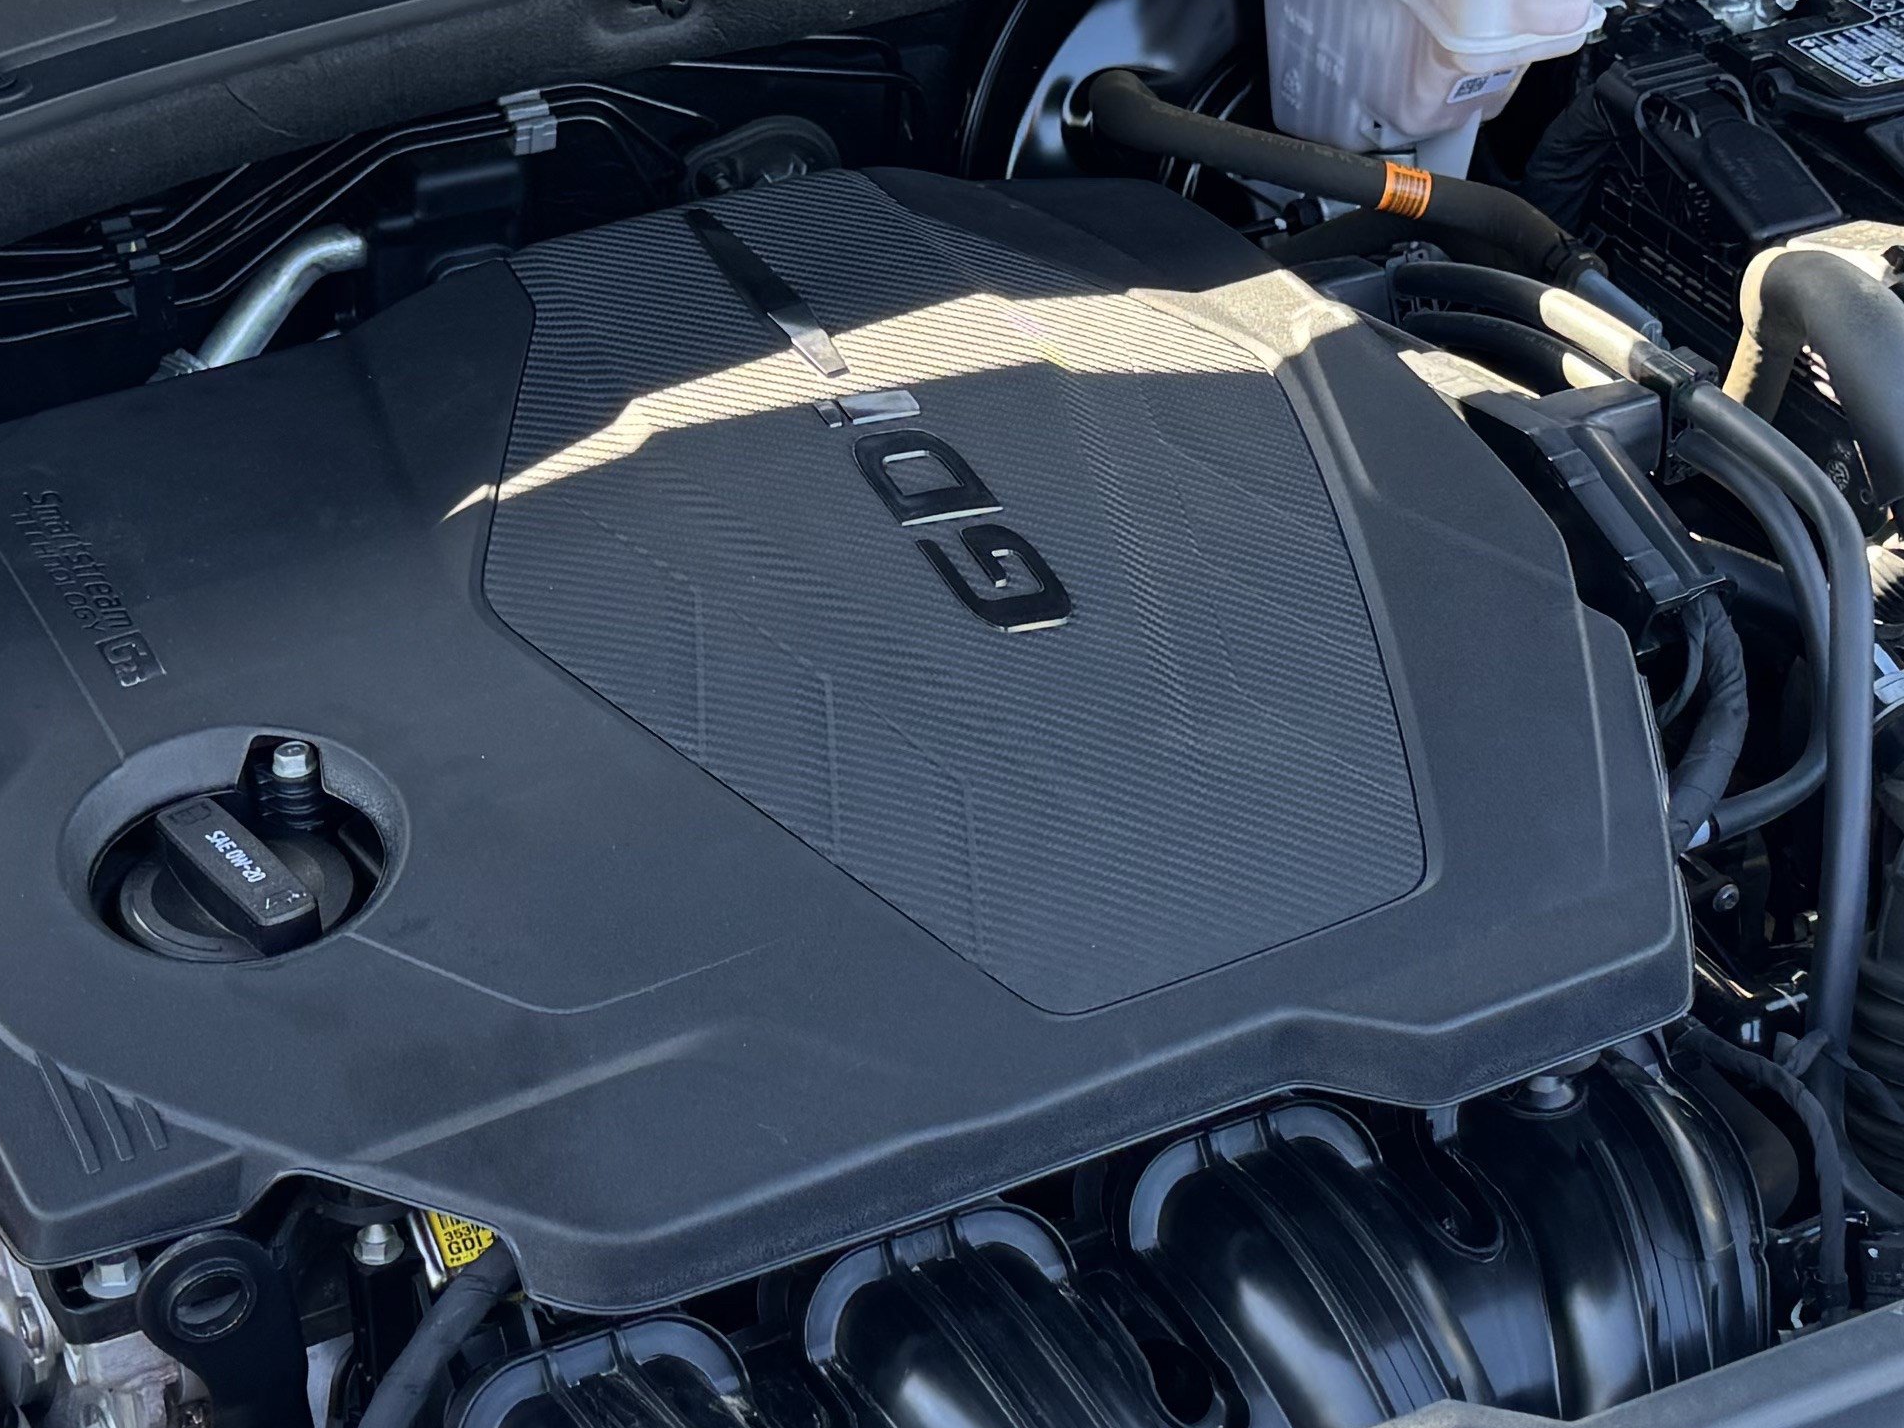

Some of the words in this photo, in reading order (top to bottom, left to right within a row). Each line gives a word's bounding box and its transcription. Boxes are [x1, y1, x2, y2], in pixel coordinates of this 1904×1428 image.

[22, 489, 134, 629] Smartstream
[204, 828, 237, 859] SAE
[226, 848, 268, 884] 0W-20
[447, 1234, 483, 1256] GDI
